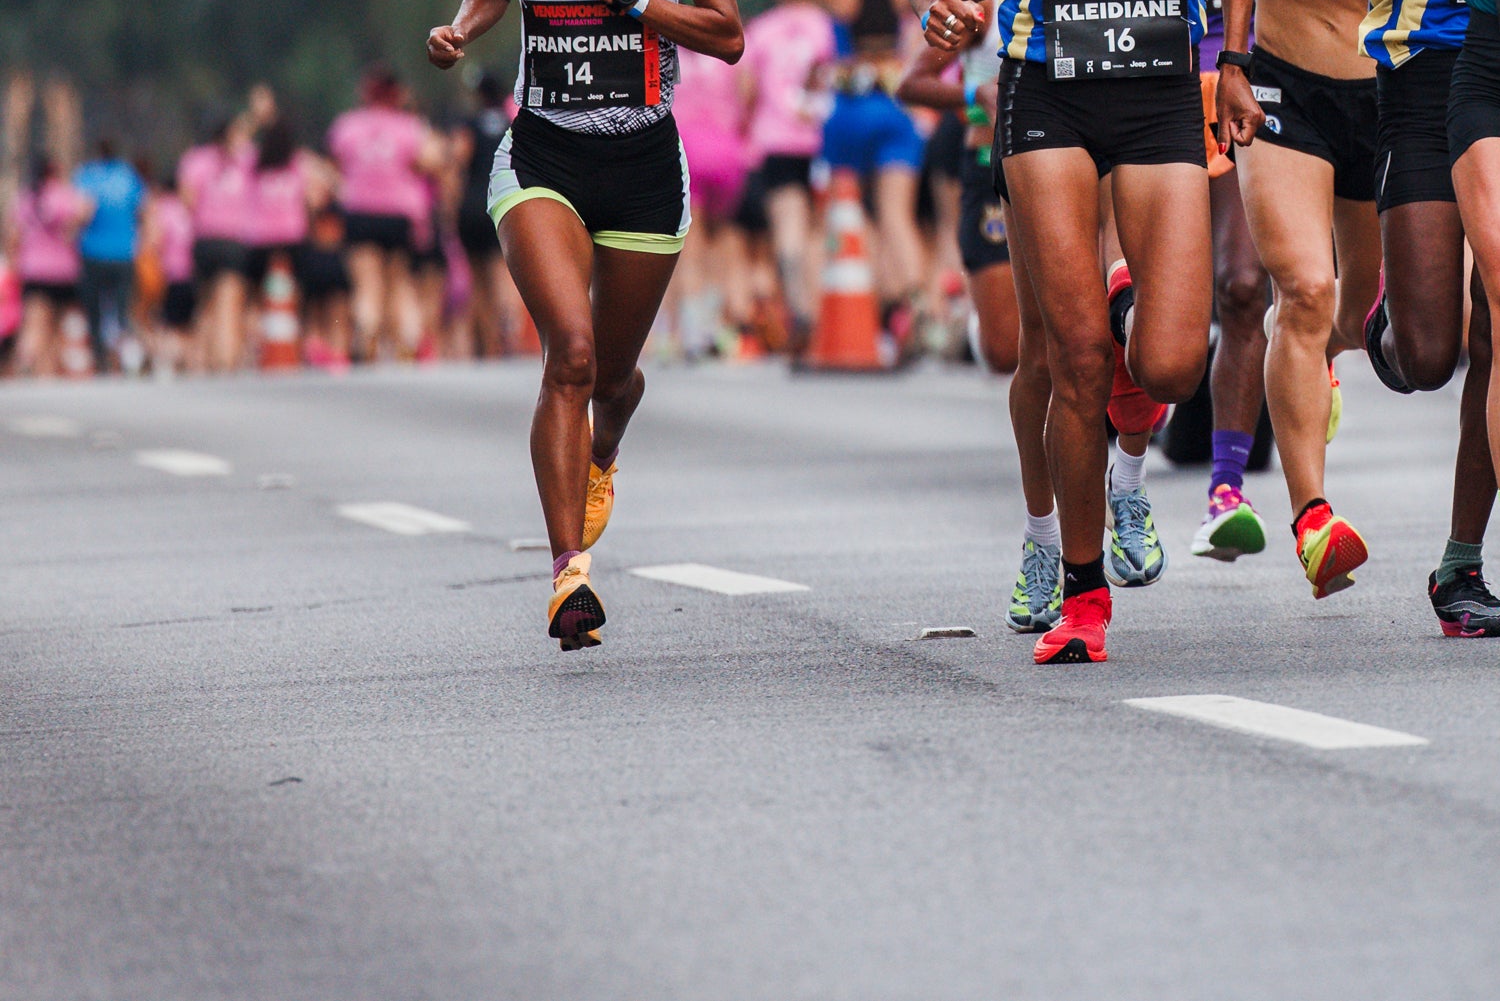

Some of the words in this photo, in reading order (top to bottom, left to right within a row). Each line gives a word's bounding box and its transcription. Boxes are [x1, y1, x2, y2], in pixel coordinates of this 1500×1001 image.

[533, 5, 625, 18] VENUSWOME
[1054, 0, 1182, 22] KLEIDIANE
[527, 33, 643, 54] FRANCIANE
[1103, 27, 1136, 53] 16
[563, 61, 594, 86] 14
[1129, 60, 1147, 68] Jeep
[587, 93, 604, 101] Jeep
